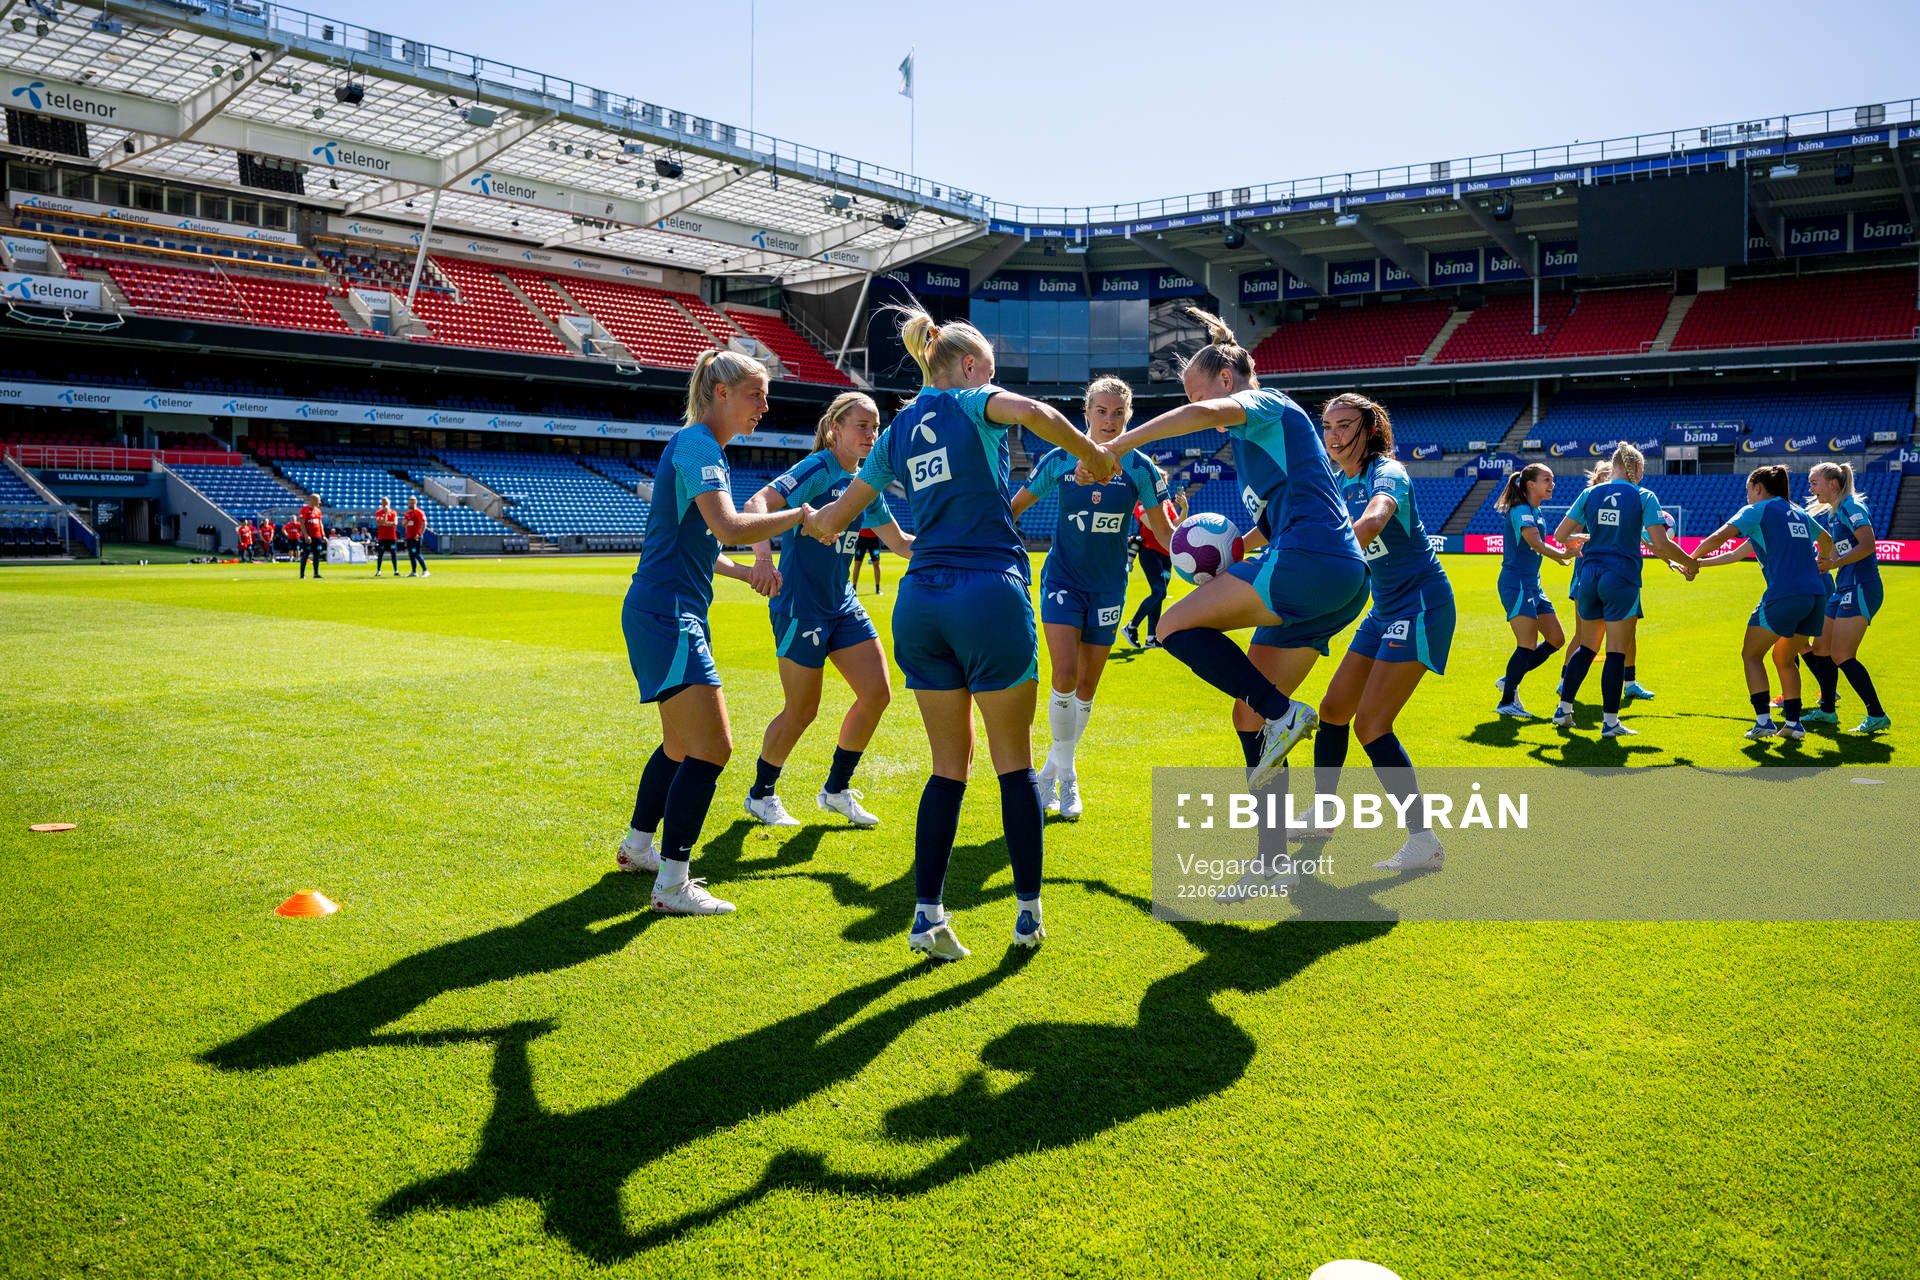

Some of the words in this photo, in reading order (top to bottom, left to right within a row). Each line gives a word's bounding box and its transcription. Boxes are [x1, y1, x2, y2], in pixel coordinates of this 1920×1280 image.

[46, 90, 117, 118] telenor
[1852, 134, 1880, 145] bama
[1797, 141, 1825, 151] bama
[1745, 148, 1771, 158] bama
[338, 149, 390, 171] telenor
[1510, 177, 1532, 187] bama
[1554, 172, 1576, 182] bama
[492, 180, 536, 200] telenor
[1425, 186, 1446, 196] bama
[1467, 182, 1489, 191] bama
[1385, 190, 1406, 200] bama
[38, 200, 72, 212] telenor
[117, 211, 149, 223] telenor
[359, 224, 384, 235] telenor
[666, 217, 702, 232] telenor
[1863, 222, 1914, 238] bama
[1791, 229, 1840, 245] bama
[15, 244, 46, 255] telenor
[766, 236, 799, 251] telenor
[1545, 251, 1578, 266] bam
[1435, 262, 1474, 276] bama
[926, 272, 961, 288] bama
[1334, 271, 1370, 285] bama
[1039, 278, 1077, 292] bama
[1102, 277, 1139, 292] bama
[1244, 280, 1277, 293] bama
[32, 283, 88, 300] telenor
[73, 391, 111, 404] telenor
[157, 397, 193, 409] telenor
[236, 402, 269, 413] telenor
[308, 407, 339, 417] telenor
[376, 411, 404, 421] telenor
[439, 415, 465, 425] telenor
[497, 418, 523, 428] telenor
[553, 422, 577, 431] telenor
[605, 425, 628, 434] telenor
[1684, 430, 1718, 442] bama
[1749, 435, 1774, 449] Bendit
[1791, 435, 1817, 449] Bendit
[1836, 434, 1862, 448] Bendit
[1556, 440, 1578, 453] Bendit
[915, 455, 943, 483] 5G
[1194, 462, 1222, 474] bama
[1479, 457, 1513, 470] bama
[58, 473, 99, 481] ULLEVAAL
[100, 474, 135, 482] STADION
[1095, 517, 1120, 529] 5G
[1600, 512, 1617, 523] 5G
[1792, 525, 1806, 535] 5G
[1837, 543, 1849, 553] 5G
[1101, 609, 1119, 623] 5G
